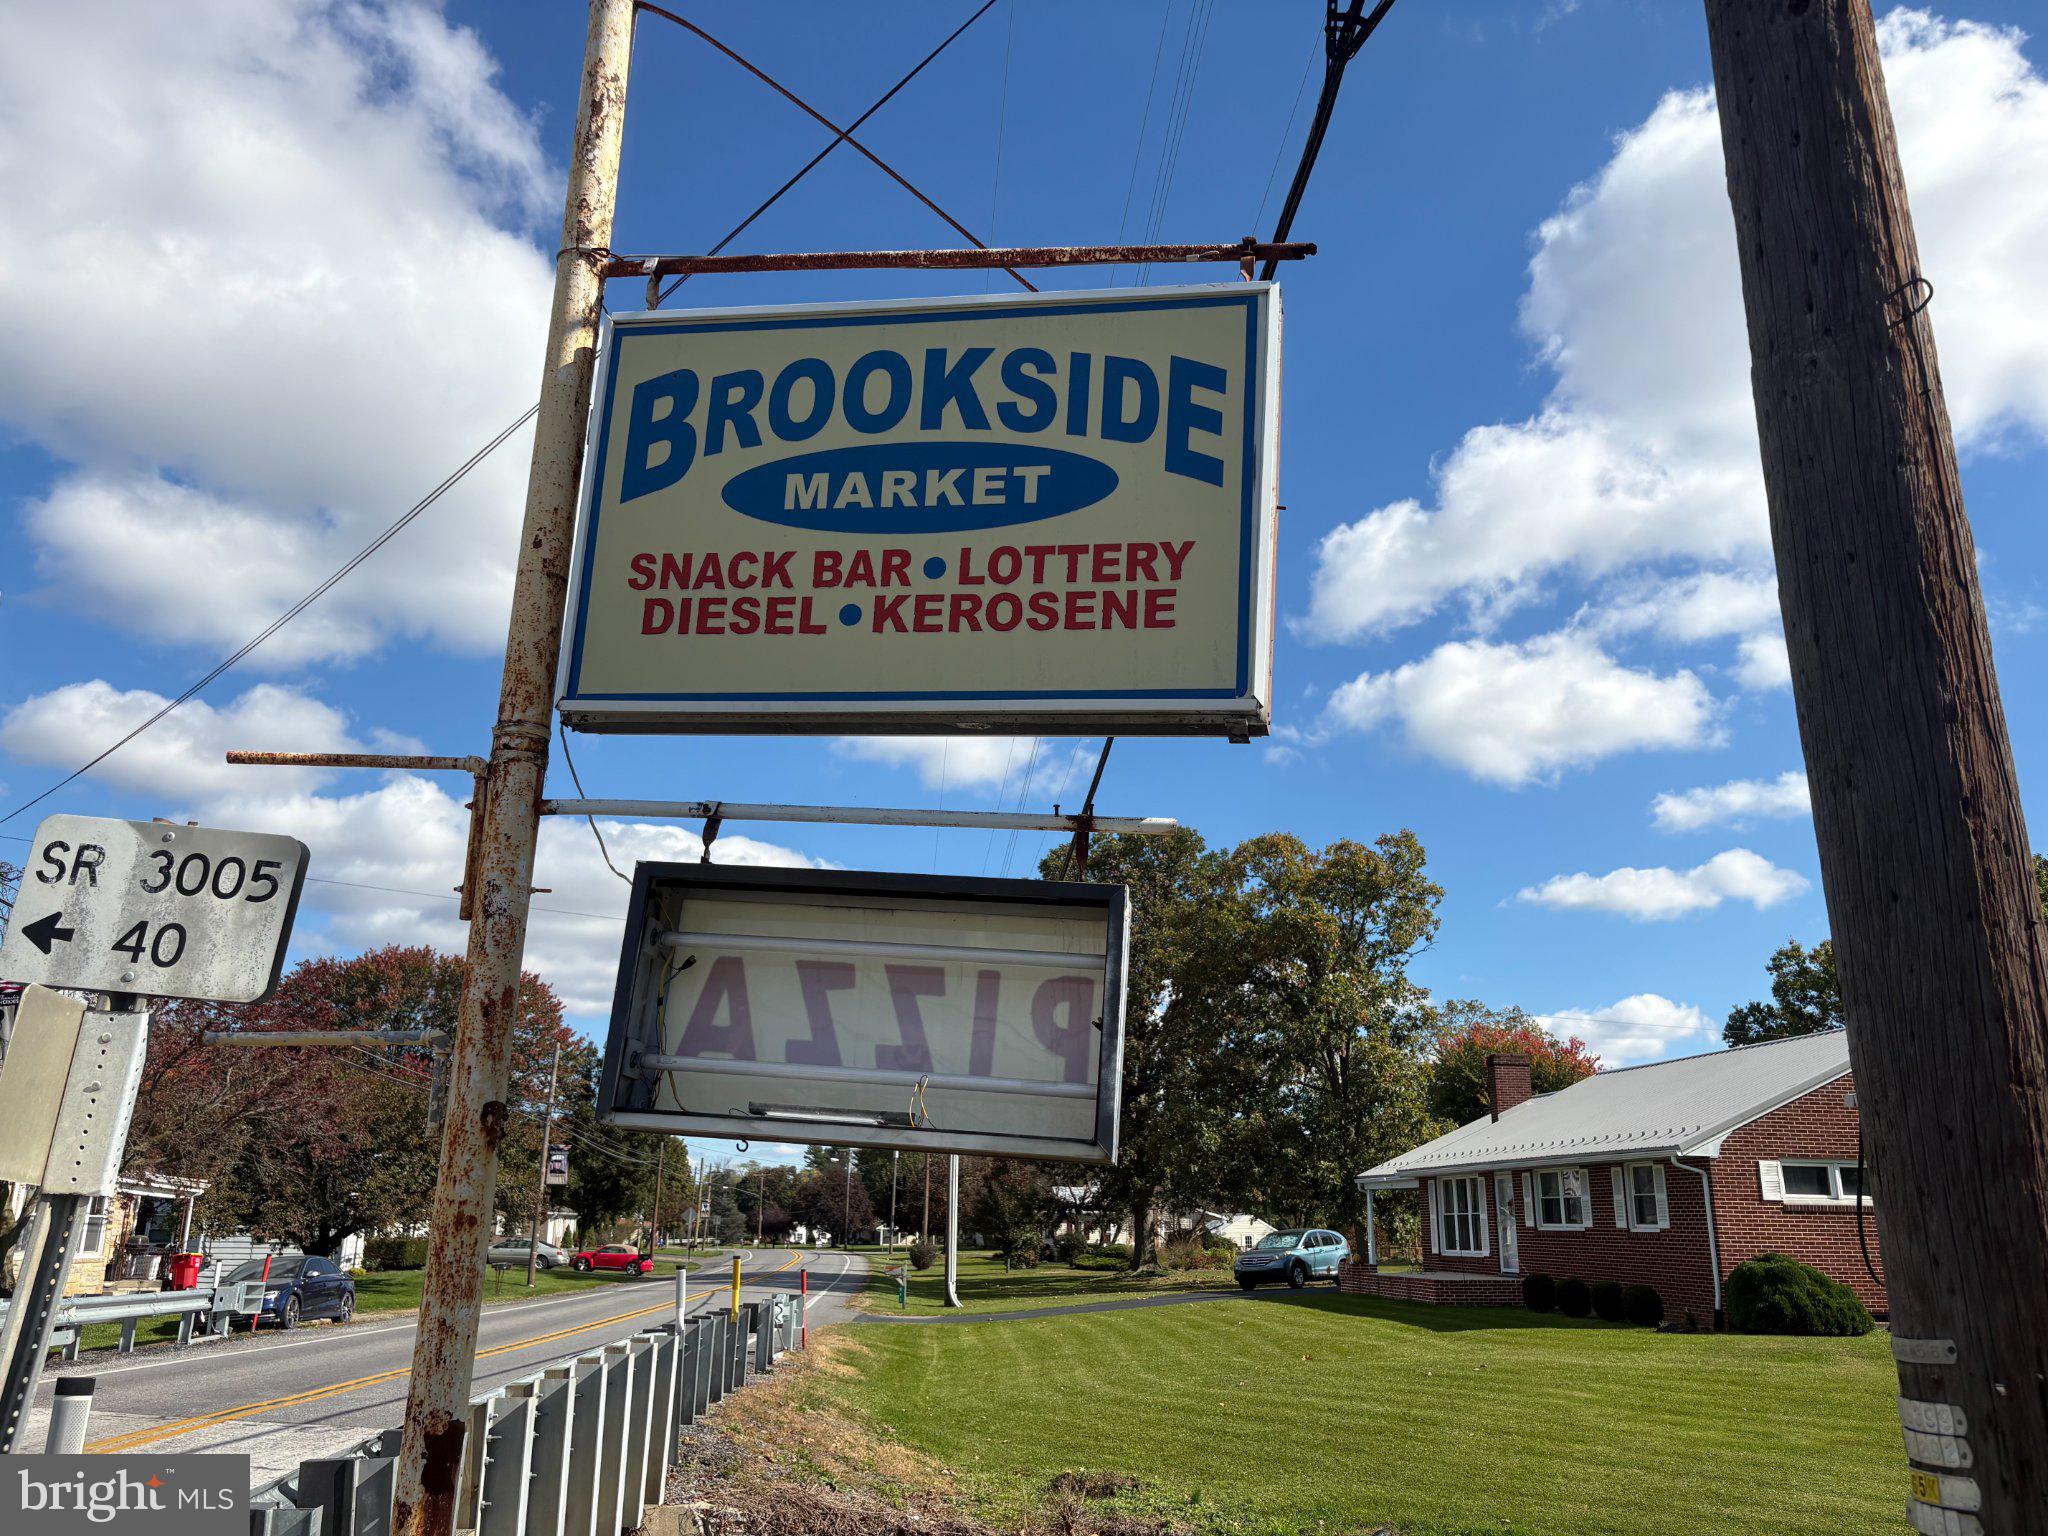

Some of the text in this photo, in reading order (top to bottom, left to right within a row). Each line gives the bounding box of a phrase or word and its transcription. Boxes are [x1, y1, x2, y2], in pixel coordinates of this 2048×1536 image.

[621, 348, 1227, 503] BROOKSIDE
[783, 465, 1052, 510] MARKET
[628, 541, 1195, 590] SNACK BAR LOTTERY
[641, 588, 1177, 635] DIESEL KEROSENE
[36, 840, 283, 903] SR 3005
[111, 920, 187, 968] 40
